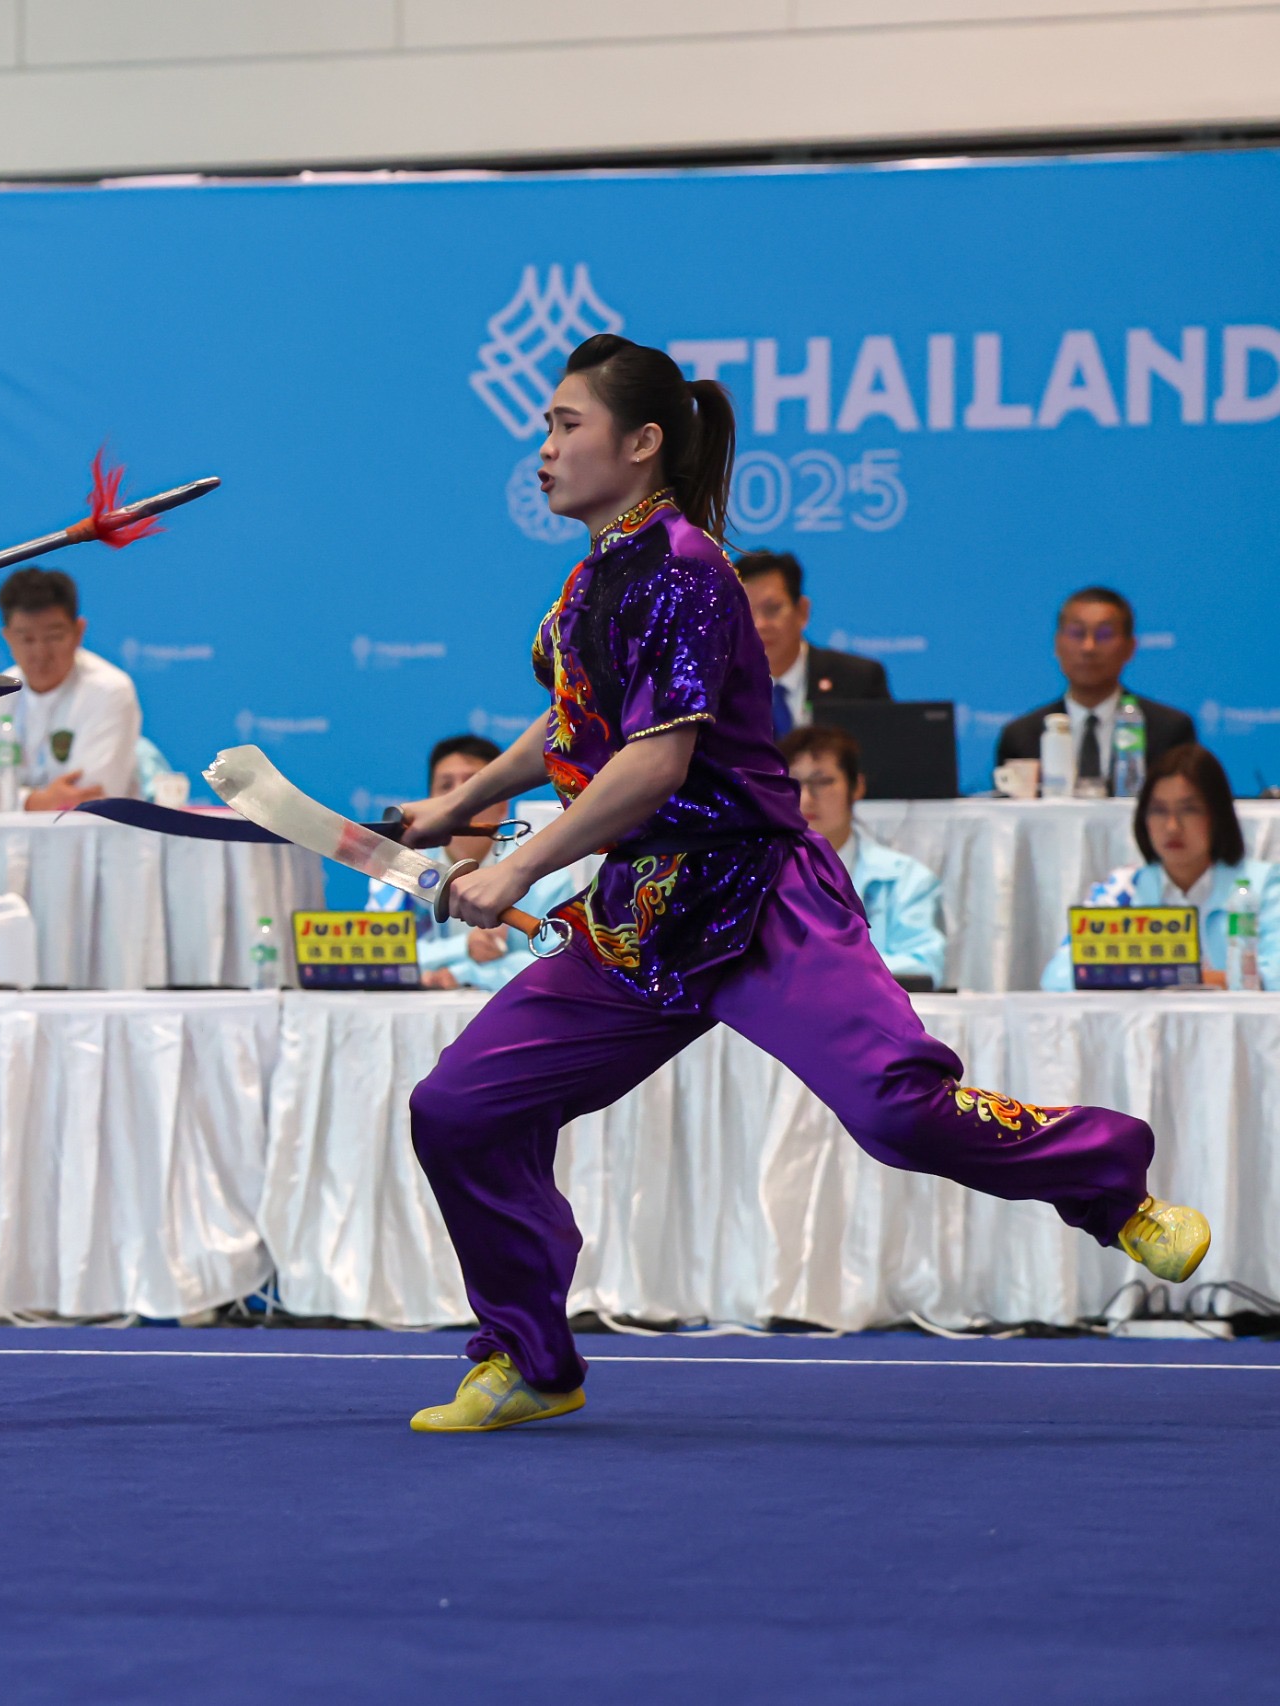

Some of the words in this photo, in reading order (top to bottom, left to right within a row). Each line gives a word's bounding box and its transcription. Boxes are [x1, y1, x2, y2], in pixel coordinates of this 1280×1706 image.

[667, 325, 1280, 434] THAILAND
[730, 449, 908, 534] 025
[300, 917, 410, 936] JustTool
[1075, 913, 1191, 934] JustTool
